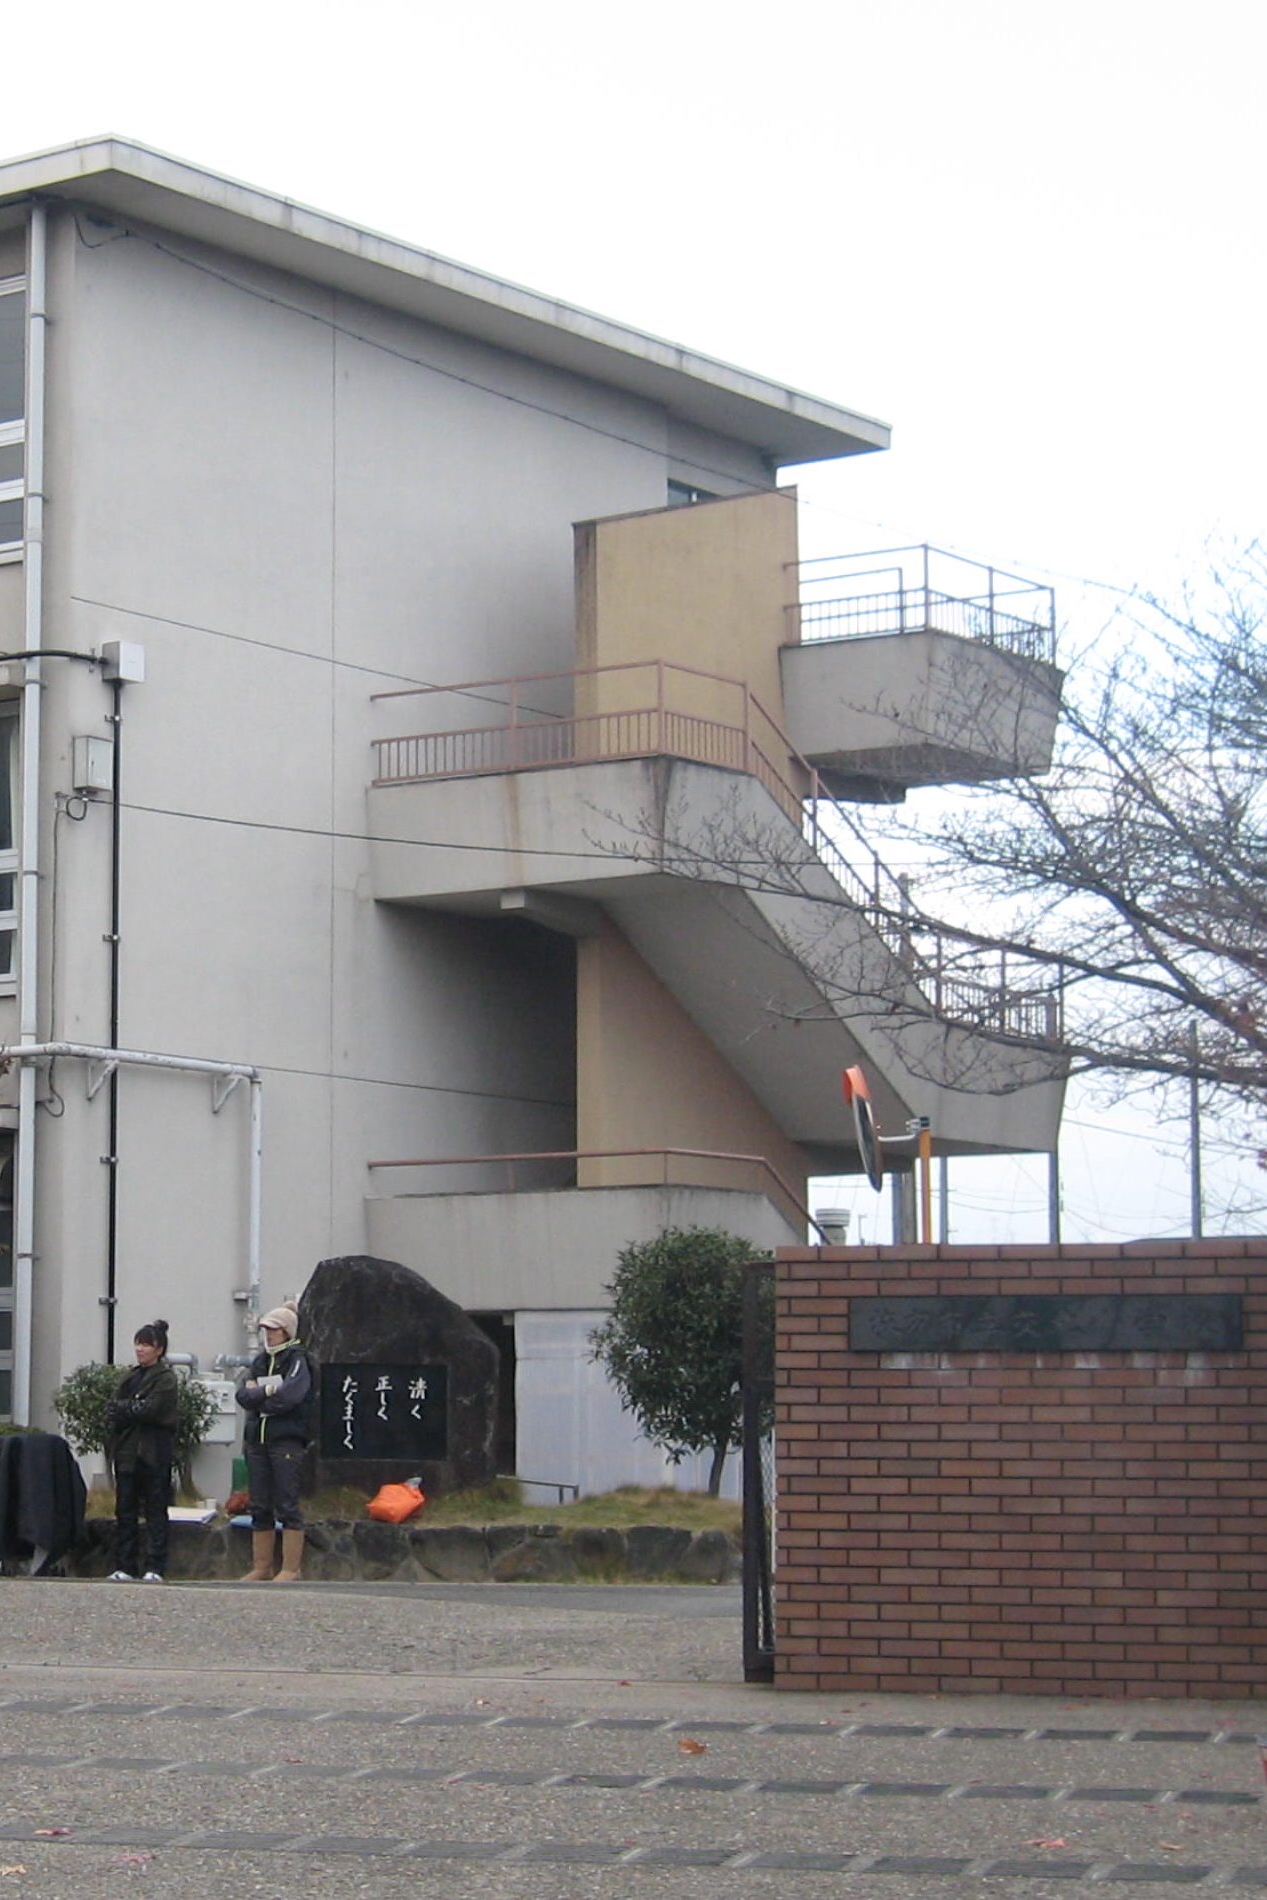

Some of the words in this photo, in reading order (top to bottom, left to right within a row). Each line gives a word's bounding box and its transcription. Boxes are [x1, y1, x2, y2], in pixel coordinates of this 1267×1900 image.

[341, 1375, 358, 1450] たくましく
[375, 1375, 392, 1421] 正しく
[408, 1377, 427, 1420] 清く
